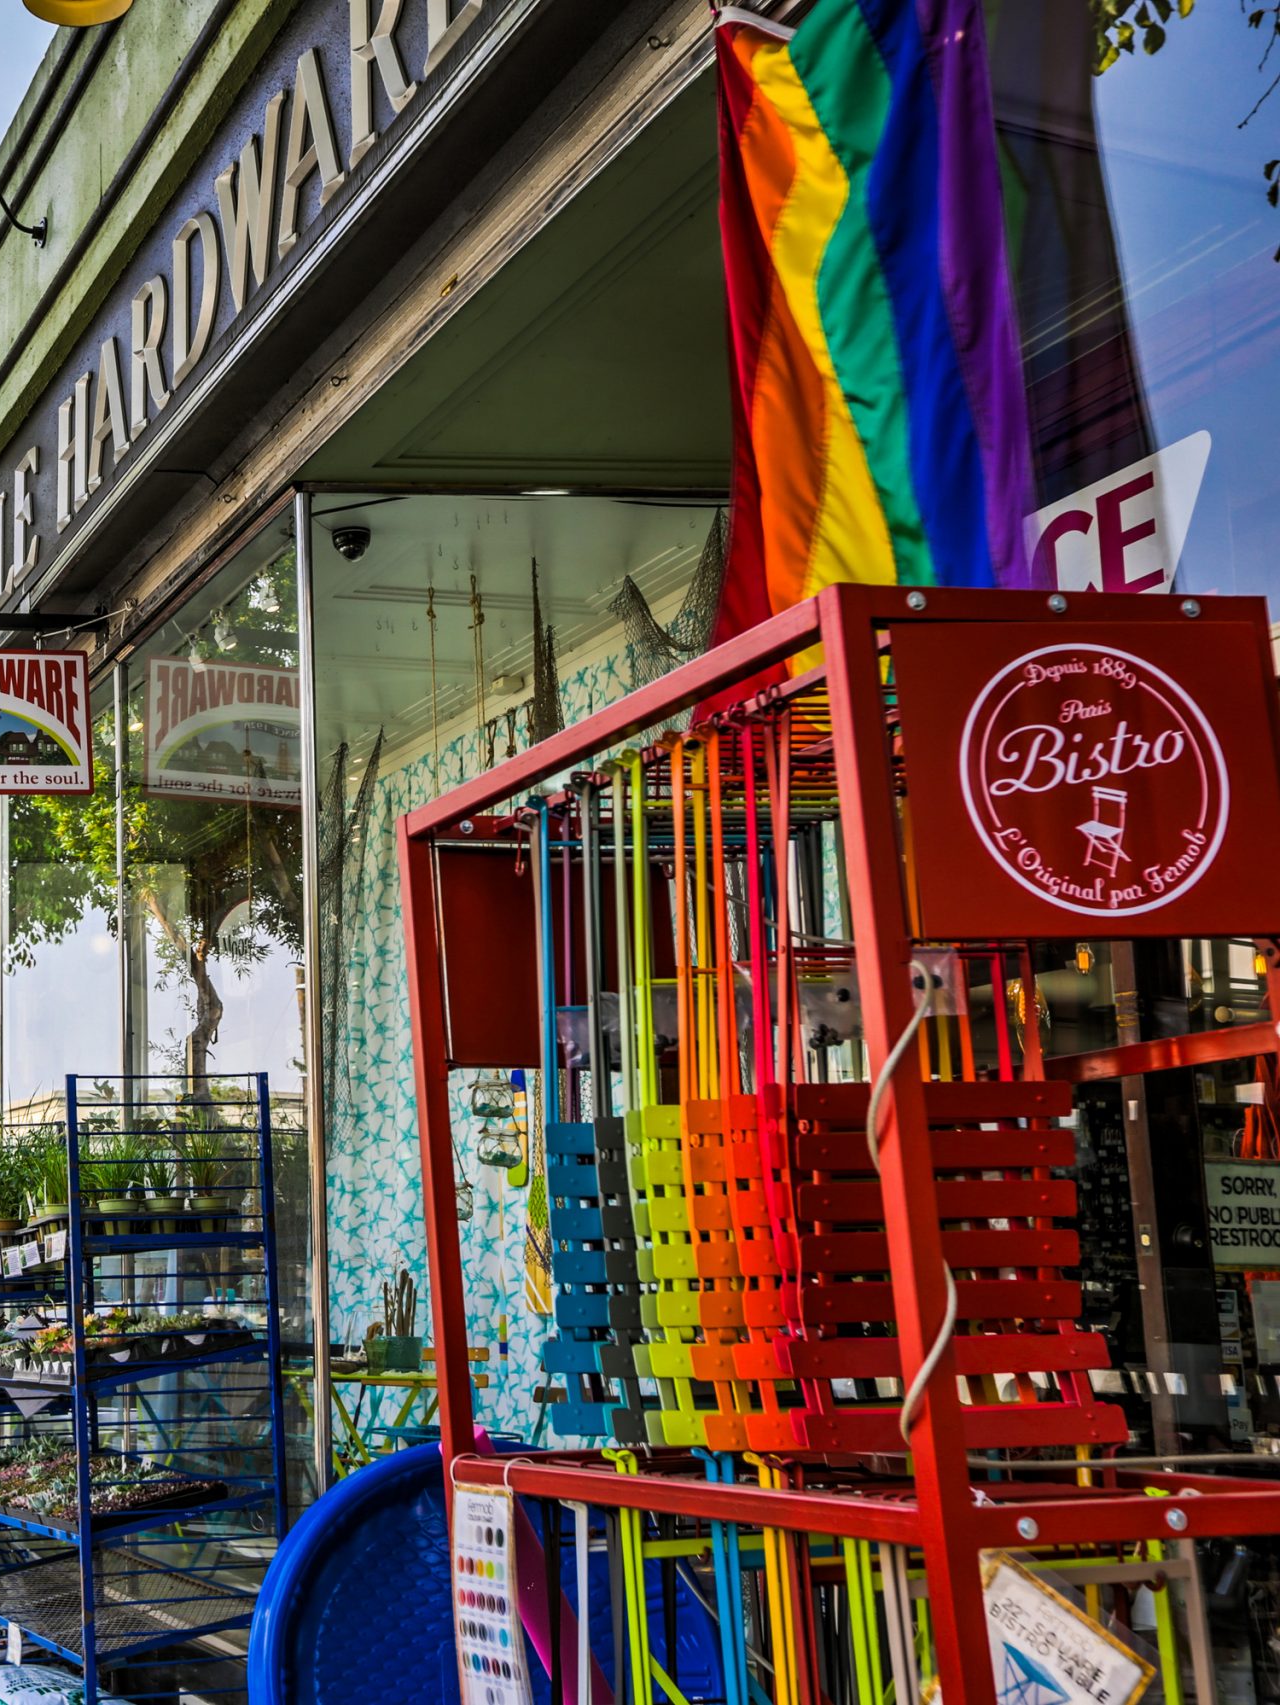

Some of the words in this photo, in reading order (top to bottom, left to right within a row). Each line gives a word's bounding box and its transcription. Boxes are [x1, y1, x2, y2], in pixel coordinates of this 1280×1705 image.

[1024, 657, 1087, 687] Depuis
[1092, 656, 1137, 690] 1889
[1058, 699, 1112, 724] Paris
[989, 720, 1185, 796] Bistro
[13, 770, 40, 785] the
[45, 771, 85, 786] soul.
[993, 826, 1104, 902] L'Original
[1109, 883, 1147, 909] par
[1143, 828, 1208, 893] Fermob
[1221, 1175, 1278, 1199] SORRY,
[1208, 1206, 1233, 1225] NO
[1238, 1206, 1280, 1226] PUBL
[988, 1603, 1051, 1657] BISTRO
[1056, 1655, 1111, 1705] TABLE
[1034, 1621, 1106, 1685] SQUARE
